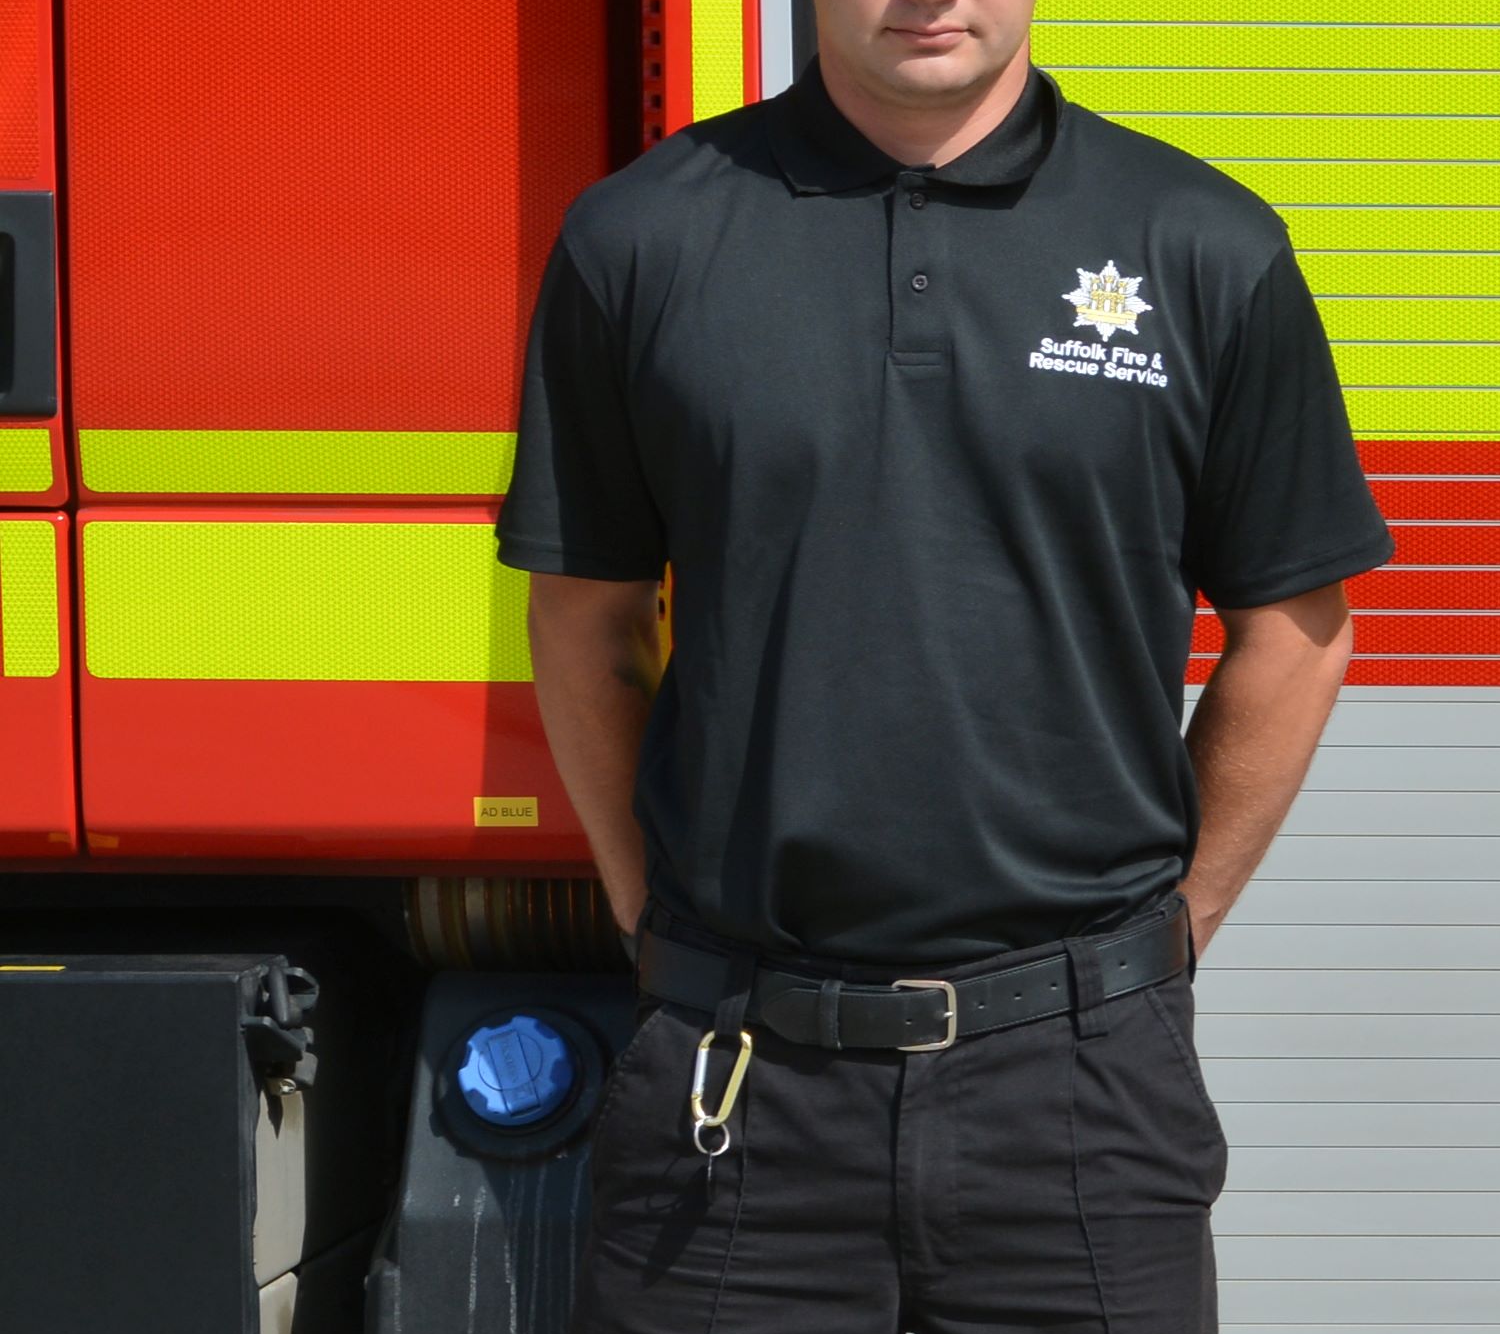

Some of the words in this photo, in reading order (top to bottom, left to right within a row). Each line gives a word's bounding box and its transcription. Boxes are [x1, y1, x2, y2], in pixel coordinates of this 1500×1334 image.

[1029, 351, 1100, 376] Rescue
[1103, 361, 1168, 388] Service
[1040, 337, 1108, 361] Suffolk
[1112, 346, 1148, 367] Fire
[1151, 352, 1163, 370] &
[481, 807, 498, 817] AD
[501, 807, 533, 817] BLUE
